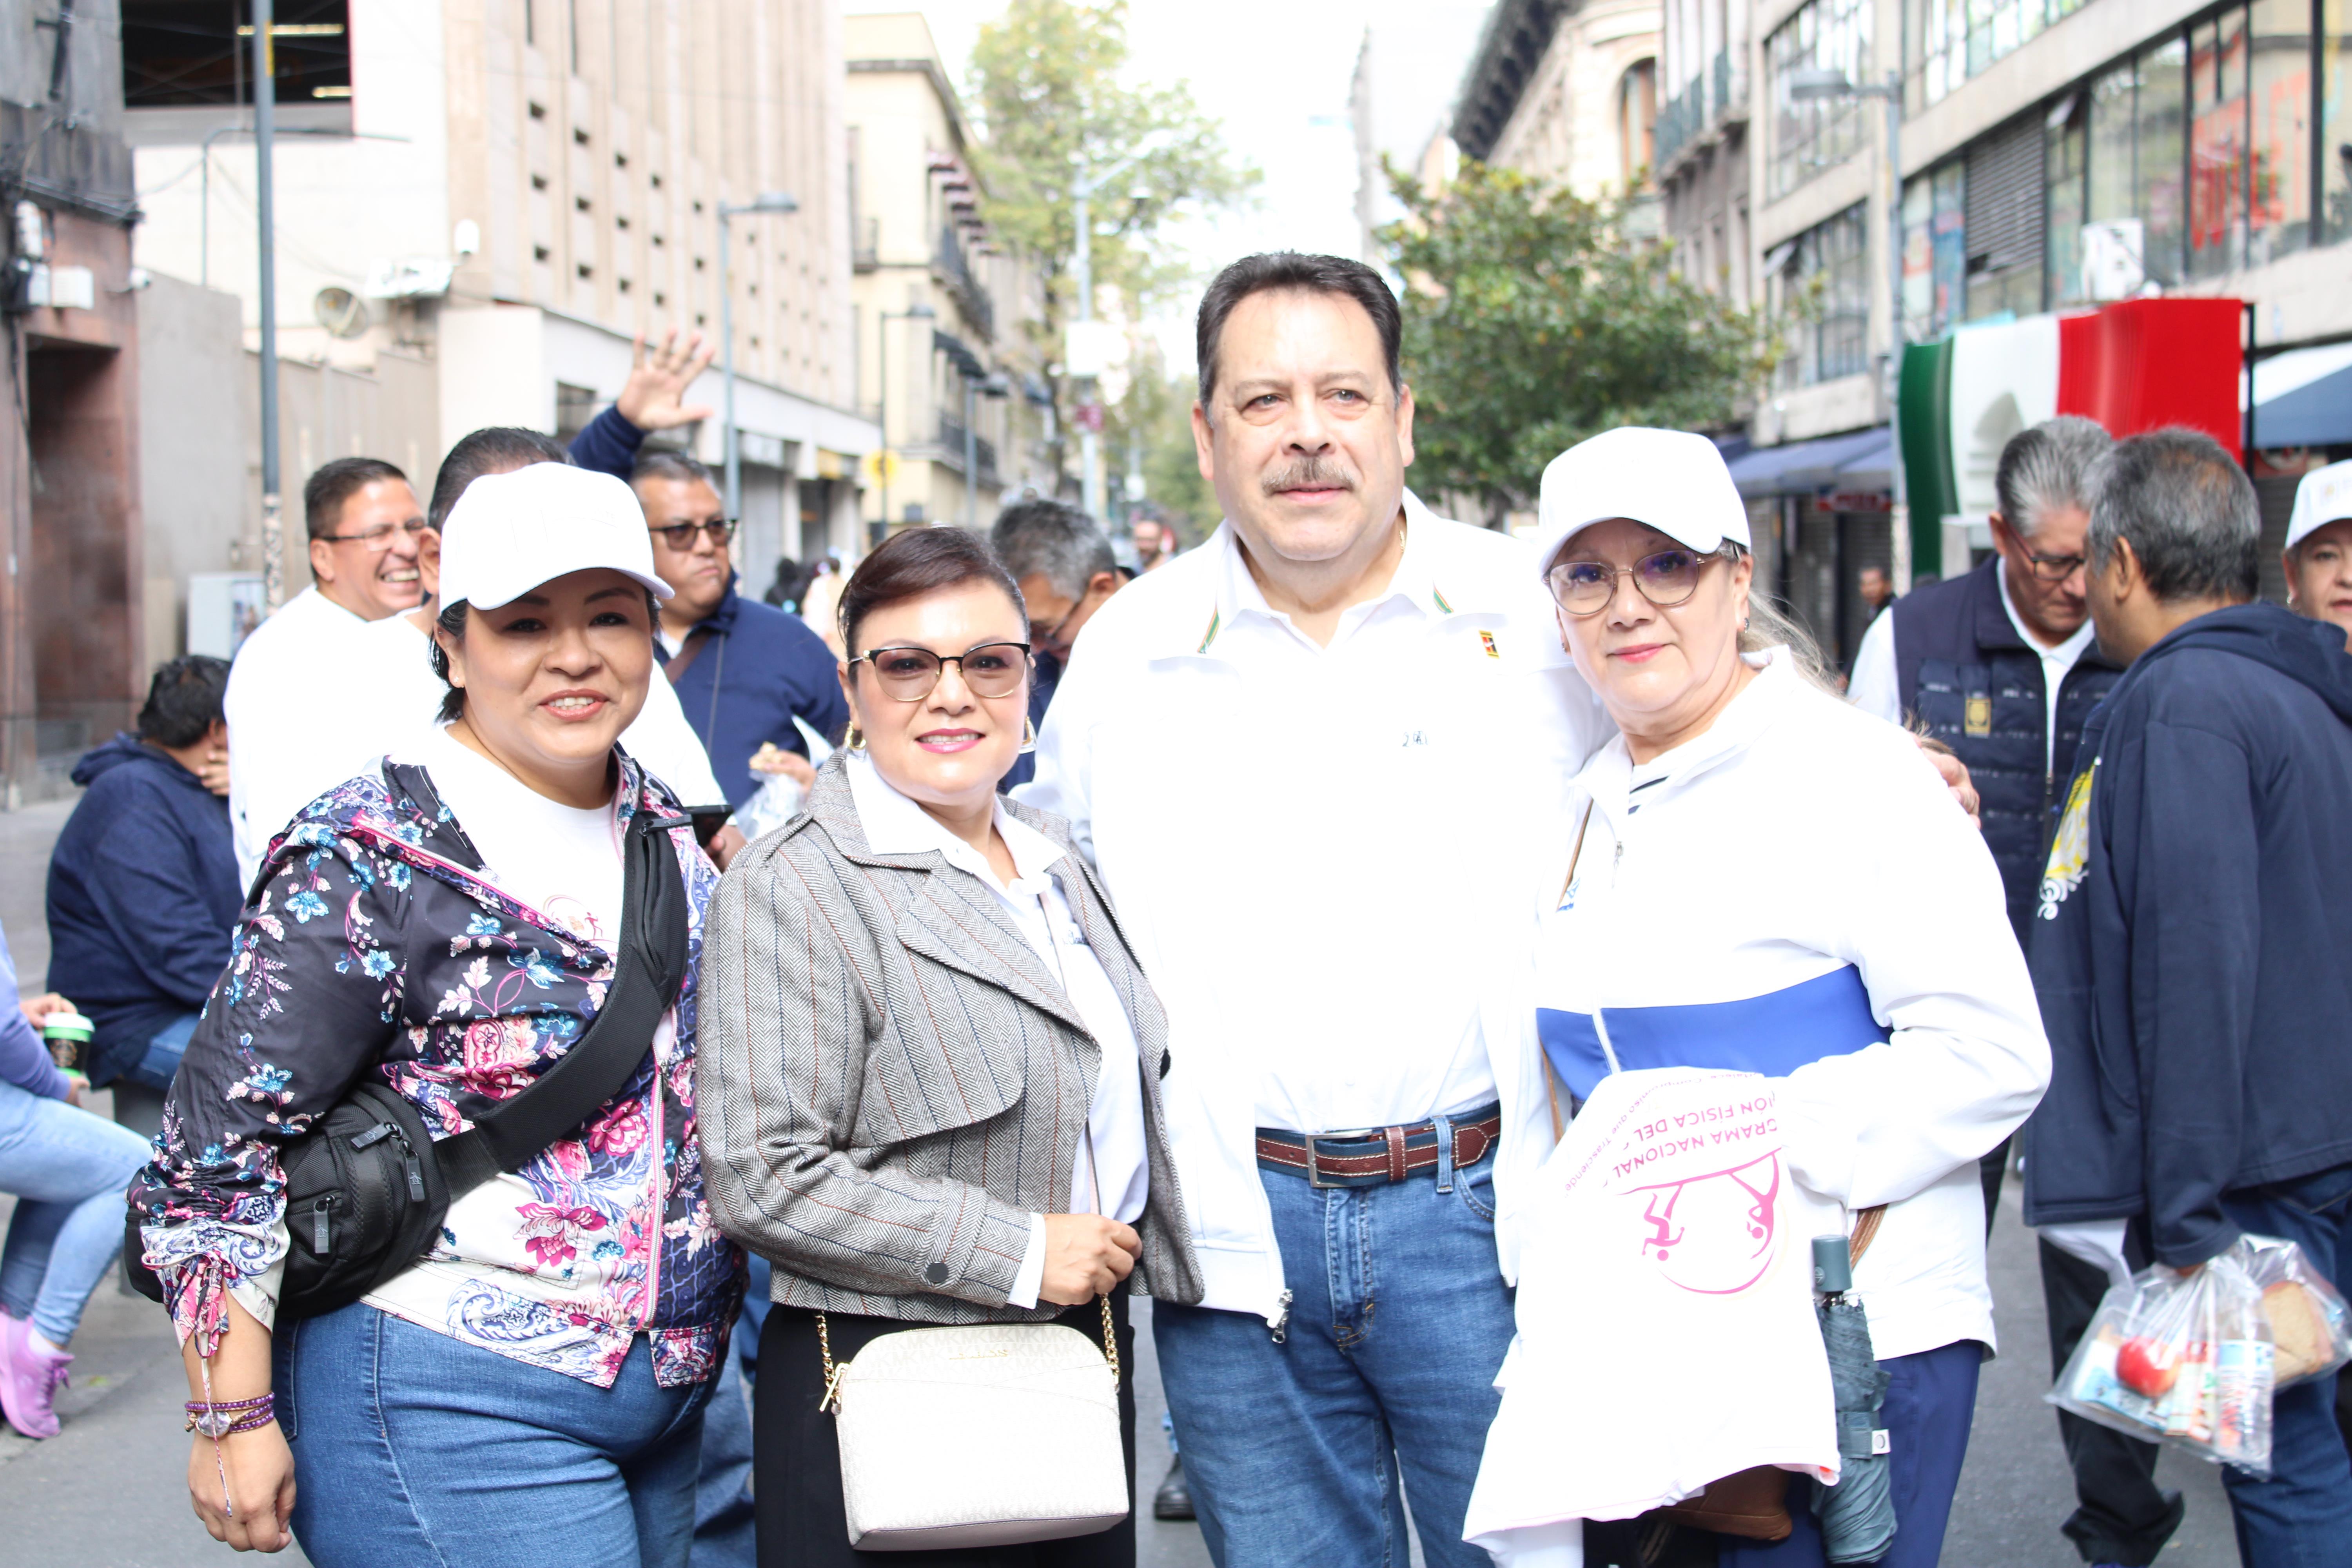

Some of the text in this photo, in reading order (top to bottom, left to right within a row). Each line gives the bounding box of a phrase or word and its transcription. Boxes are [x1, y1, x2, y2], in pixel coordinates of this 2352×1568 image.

[1629, 1078, 1702, 1113] Compromiso
[1612, 1114, 1627, 1134] que
[1673, 1105, 1734, 1128] FÍSICA
[1633, 1118, 1668, 1142] DEL
[1613, 1135, 1704, 1177] NACIONAL
